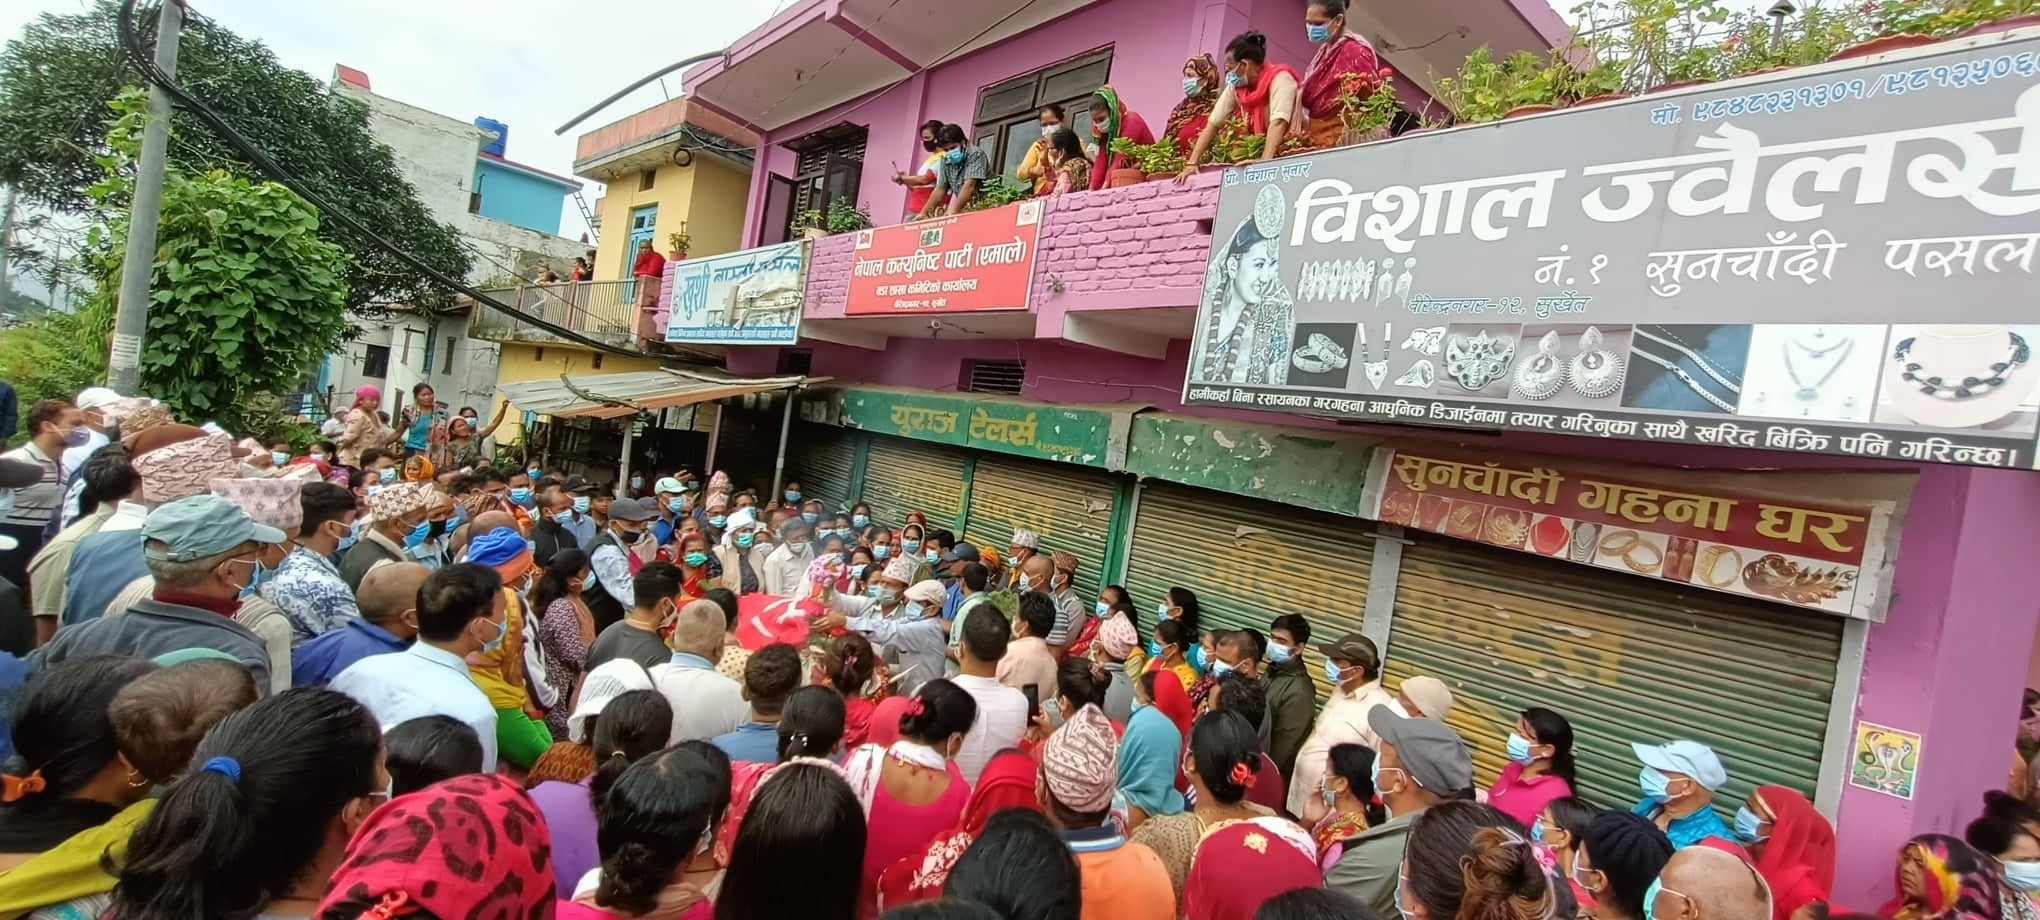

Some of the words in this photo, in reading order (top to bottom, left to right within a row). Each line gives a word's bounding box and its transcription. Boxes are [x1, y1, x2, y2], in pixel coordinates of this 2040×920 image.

[1651, 103, 1681, 125] मो.
[1693, 52, 2040, 121] ९८४८२३१३०१/९८१२५०६
[1244, 166, 1279, 184] विशाल
[1282, 161, 1312, 182] सुनार
[1290, 168, 1567, 253] विशाल
[855, 257, 884, 277] नेपाल
[886, 249, 942, 278] कम्युनिष्ट
[945, 242, 972, 269] पार्टी
[976, 236, 1027, 268] (एमाले)
[1646, 229, 1848, 297] सुनचाँदी
[1885, 232, 2040, 278] पसल
[683, 263, 711, 320] खुशी
[1535, 290, 1593, 320] सुर्खेत
[969, 407, 1038, 447] टेलर्स
[1232, 388, 1254, 404] बिना
[1257, 392, 1310, 408] रसायनका
[1313, 396, 1365, 413] गरगहना
[1368, 400, 1427, 419] आधुनिक
[1429, 403, 1508, 425] डिजाईनमा
[1510, 411, 1557, 430] तयार
[1561, 413, 1638, 438] गरिनुका
[1643, 419, 1688, 440] साथै
[1694, 423, 1758, 447] खरिद
[1766, 426, 1832, 452] बिक्रि
[1840, 432, 1892, 457] पनि
[1578, 474, 1738, 532] गहना
[1756, 502, 1864, 553] घर
